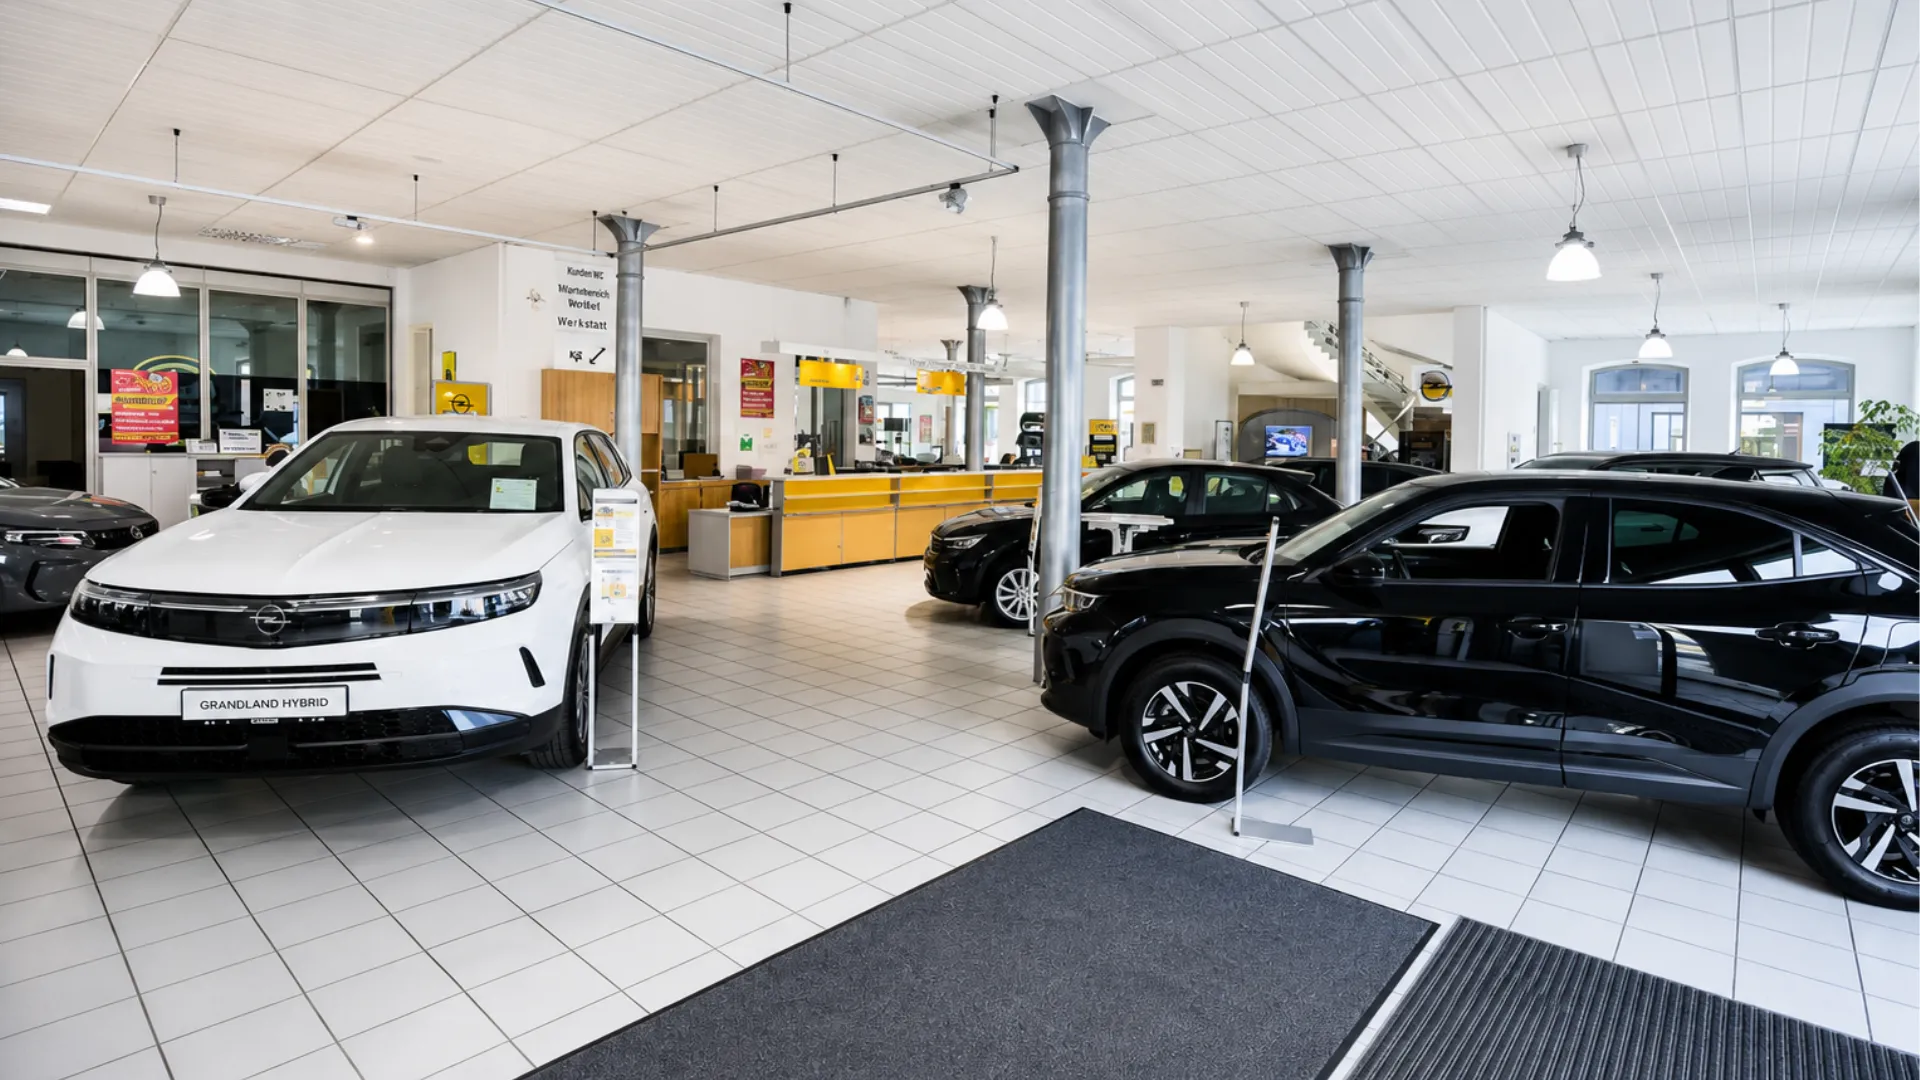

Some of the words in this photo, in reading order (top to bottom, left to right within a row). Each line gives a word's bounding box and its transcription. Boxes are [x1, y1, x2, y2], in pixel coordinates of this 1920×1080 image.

[557, 316, 607, 330] Werkstatt
[200, 700, 279, 710] GRANDLAND
[282, 698, 328, 708] HYBRID
